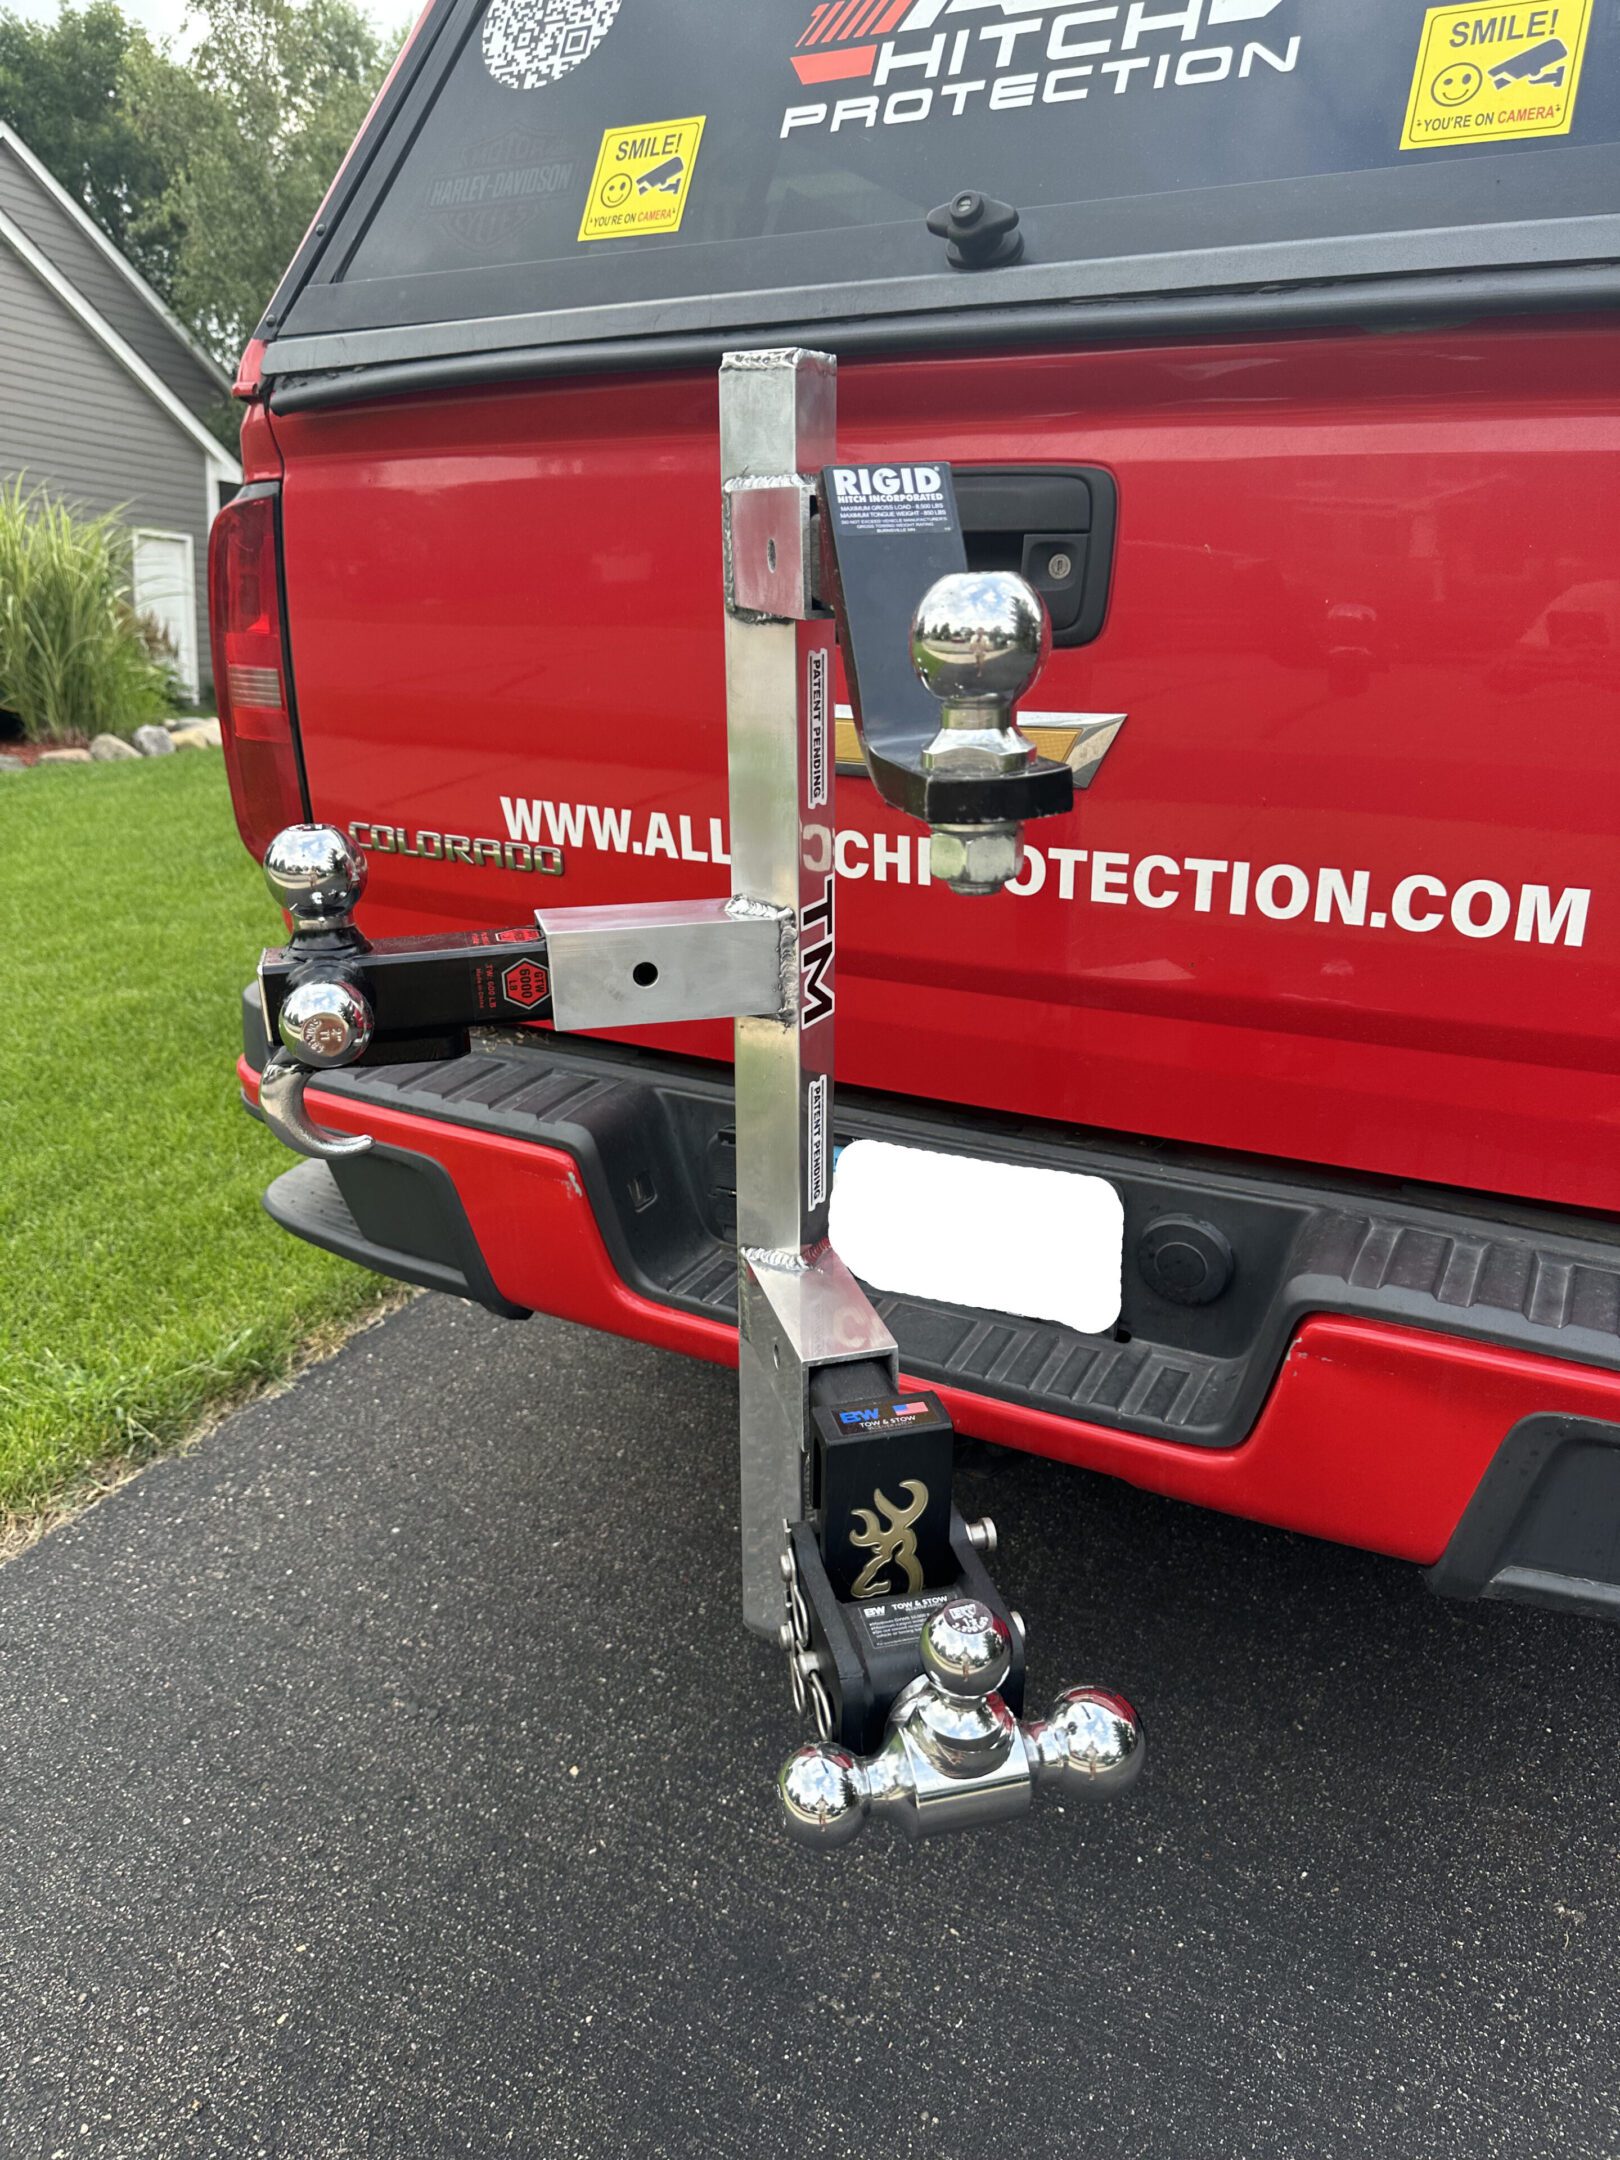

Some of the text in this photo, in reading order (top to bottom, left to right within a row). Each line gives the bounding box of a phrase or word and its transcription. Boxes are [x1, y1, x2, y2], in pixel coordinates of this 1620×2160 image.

[1449, 9, 1559, 48] SMILE!
[873, 0, 1202, 87] HITCH
[779, 36, 1301, 139] PROTECTION
[1424, 105, 1555, 132] YOU'RE ON CAMERA
[615, 133, 682, 161] SMILE!
[430, 163, 574, 208] HARLEY-DAVIDSON
[593, 209, 672, 228] YOU'RE ON CAMERA
[833, 467, 942, 495] RIGID
[837, 493, 944, 504] HITCH INCORPORATED
[812, 659, 822, 798] PATENT PENDING
[349, 821, 565, 877] COLORADO
[509, 980, 518, 991] LB
[519, 968, 533, 999] 6000
[534, 971, 545, 993] GTW
[813, 1085, 822, 1200] PATENT PENDING
[859, 1419, 881, 1428] TOW
[890, 1415, 916, 1424] STOW
[891, 1601, 913, 1610] TOW
[922, 1595, 948, 1605] STOW
